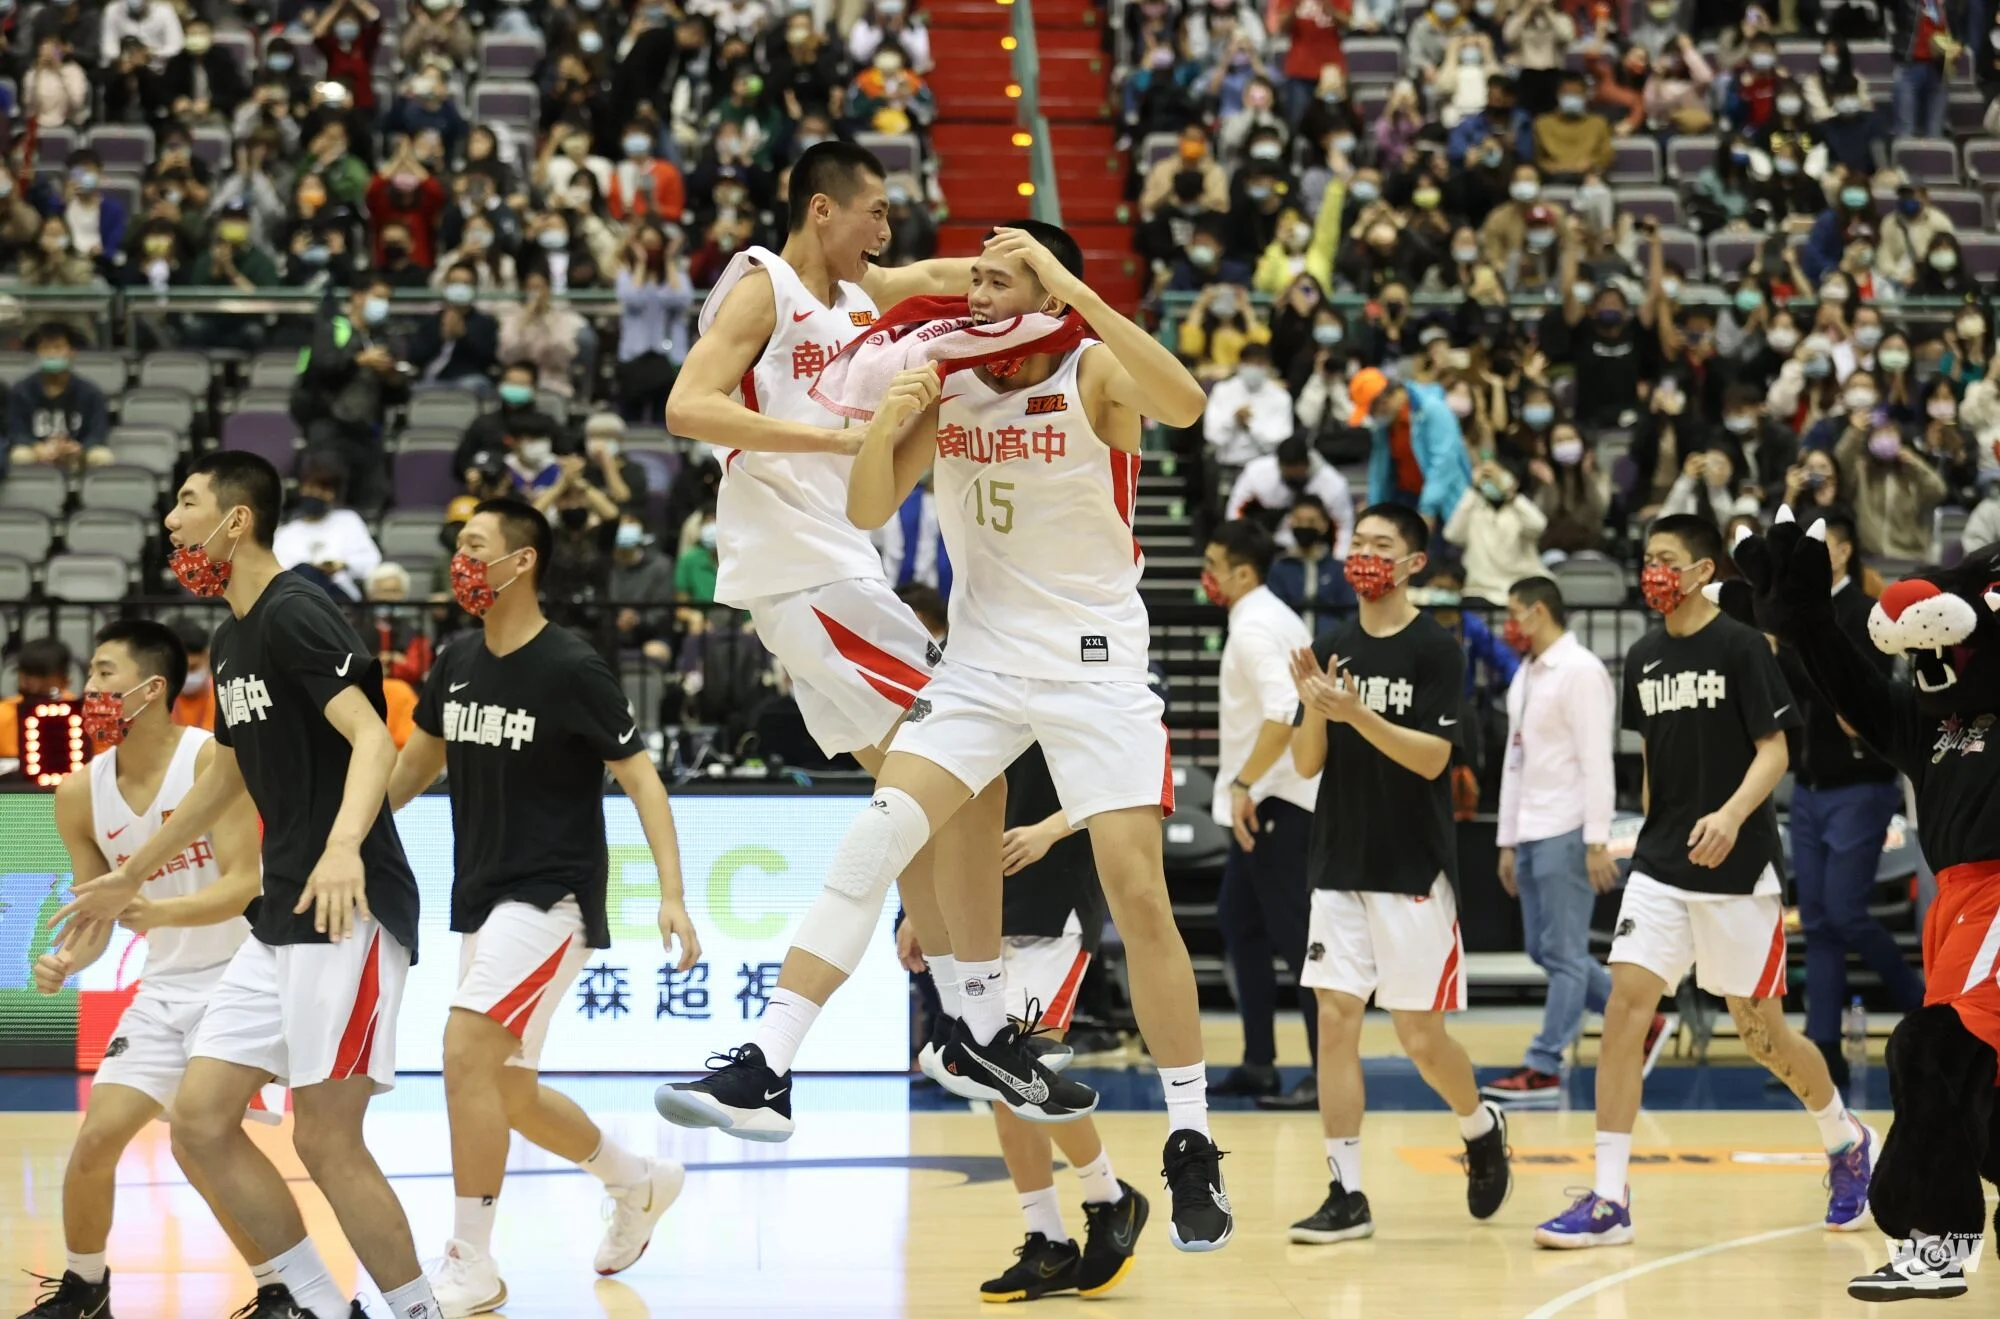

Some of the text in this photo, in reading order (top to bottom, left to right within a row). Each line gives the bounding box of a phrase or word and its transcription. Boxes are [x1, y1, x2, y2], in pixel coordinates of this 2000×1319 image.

[936, 423, 1067, 464] 南山高中
[974, 478, 1015, 535] 15
[1084, 638, 1104, 647] XXL
